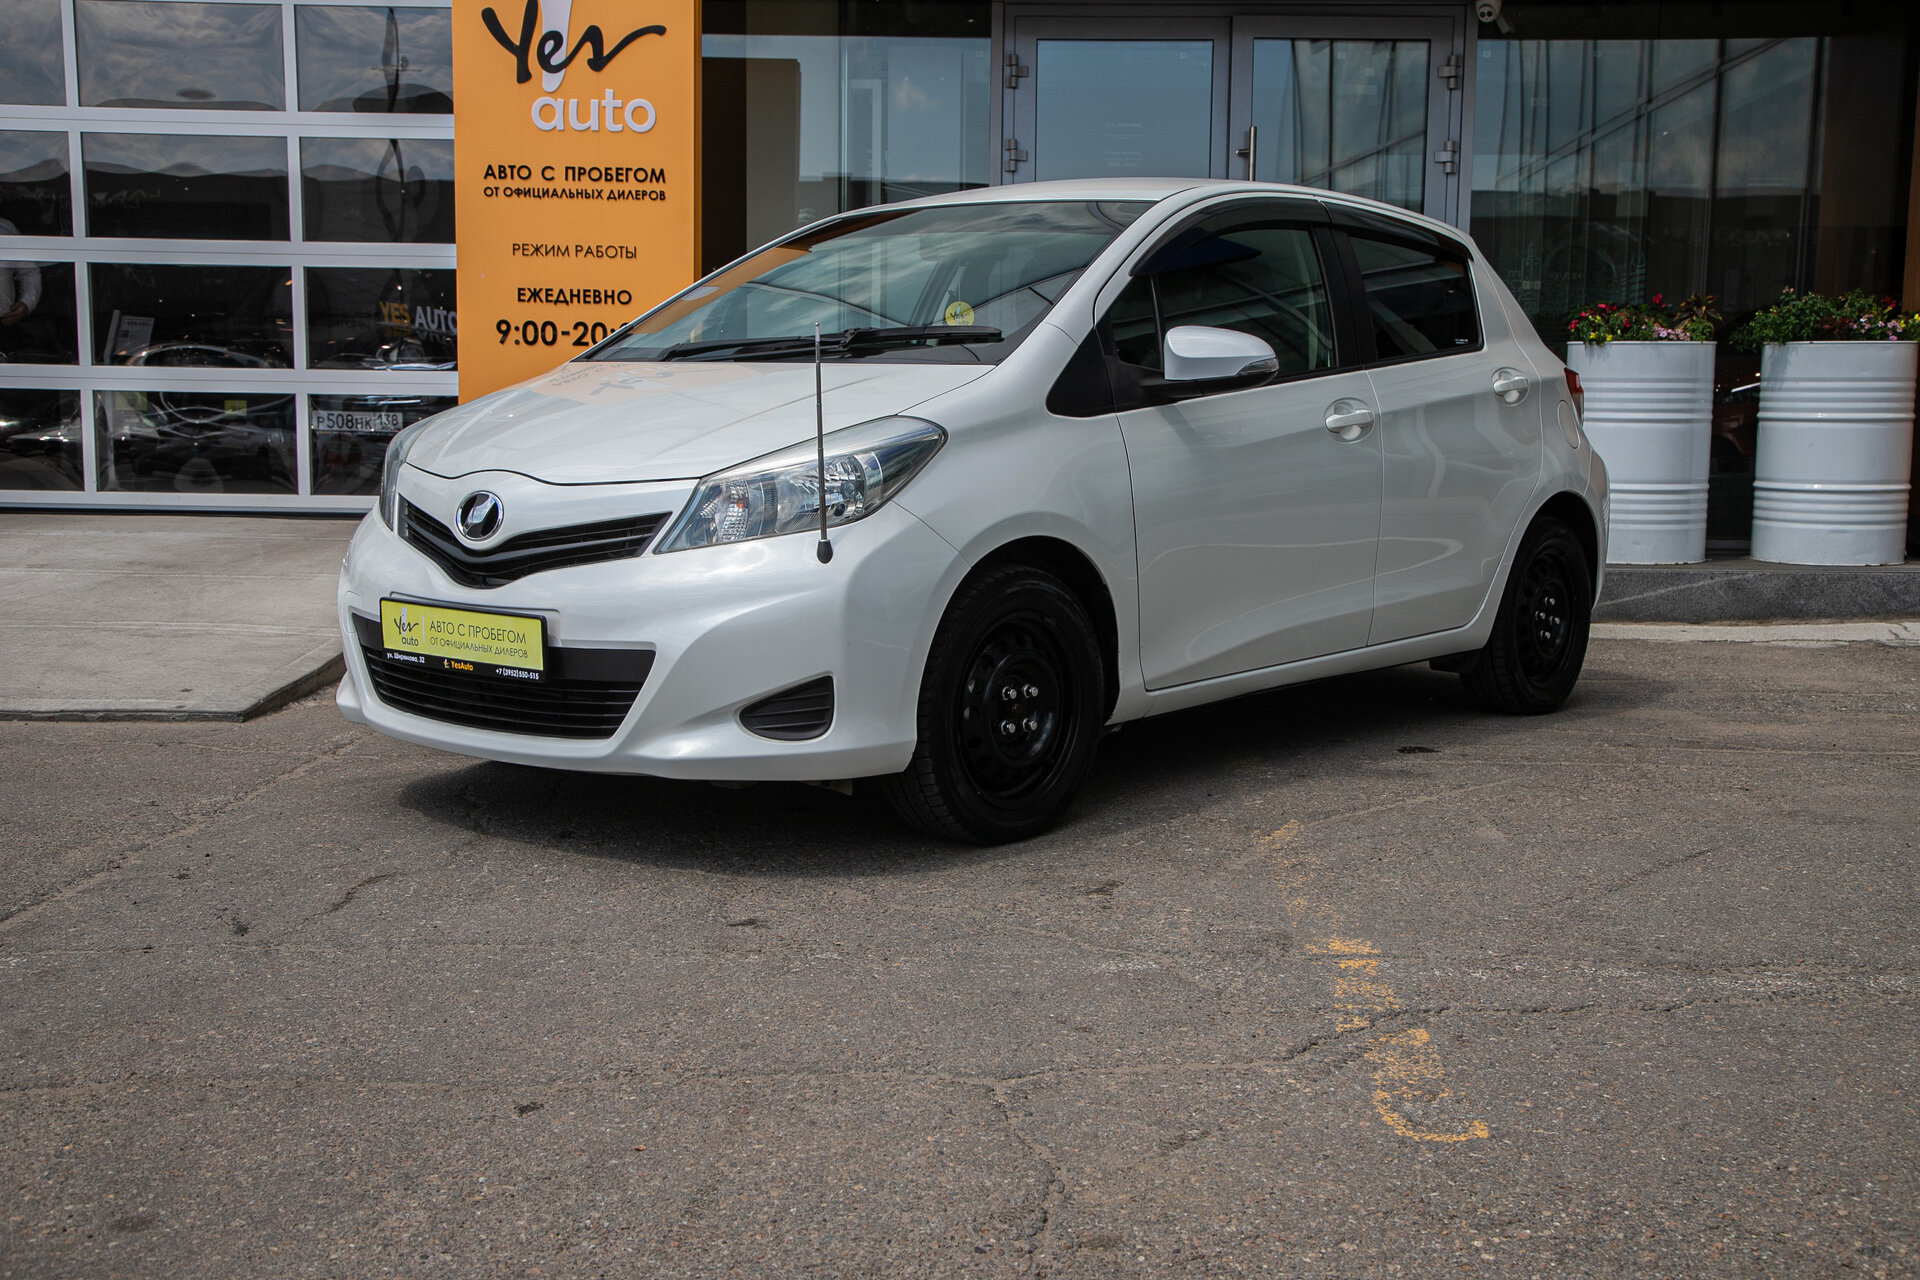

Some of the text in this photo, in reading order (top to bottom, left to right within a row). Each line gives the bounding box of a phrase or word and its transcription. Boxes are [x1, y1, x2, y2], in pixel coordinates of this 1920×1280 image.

[481, 0, 667, 84] Yes
[531, 88, 656, 133] auto
[483, 164, 666, 184] АВТО С ПРОБЕГОМ
[483, 186, 666, 202] ОТ ОФИЦИАЛЬНЫХ ДИЛЕРОВ
[512, 243, 637, 259] РЕЖИМ РАБОТЫ
[517, 287, 632, 306] ЕЖЕДНЕВНО
[379, 301, 411, 327] YES
[394, 615, 419, 635] Yes
[430, 620, 527, 644] АВТО С ПРОБЕГОМ
[401, 636, 419, 647] auto
[429, 636, 528, 659] ОТ ОФИЦИАЛЬНЫХ ДИЛЕРОВ
[450, 660, 473, 671] YesAuto
